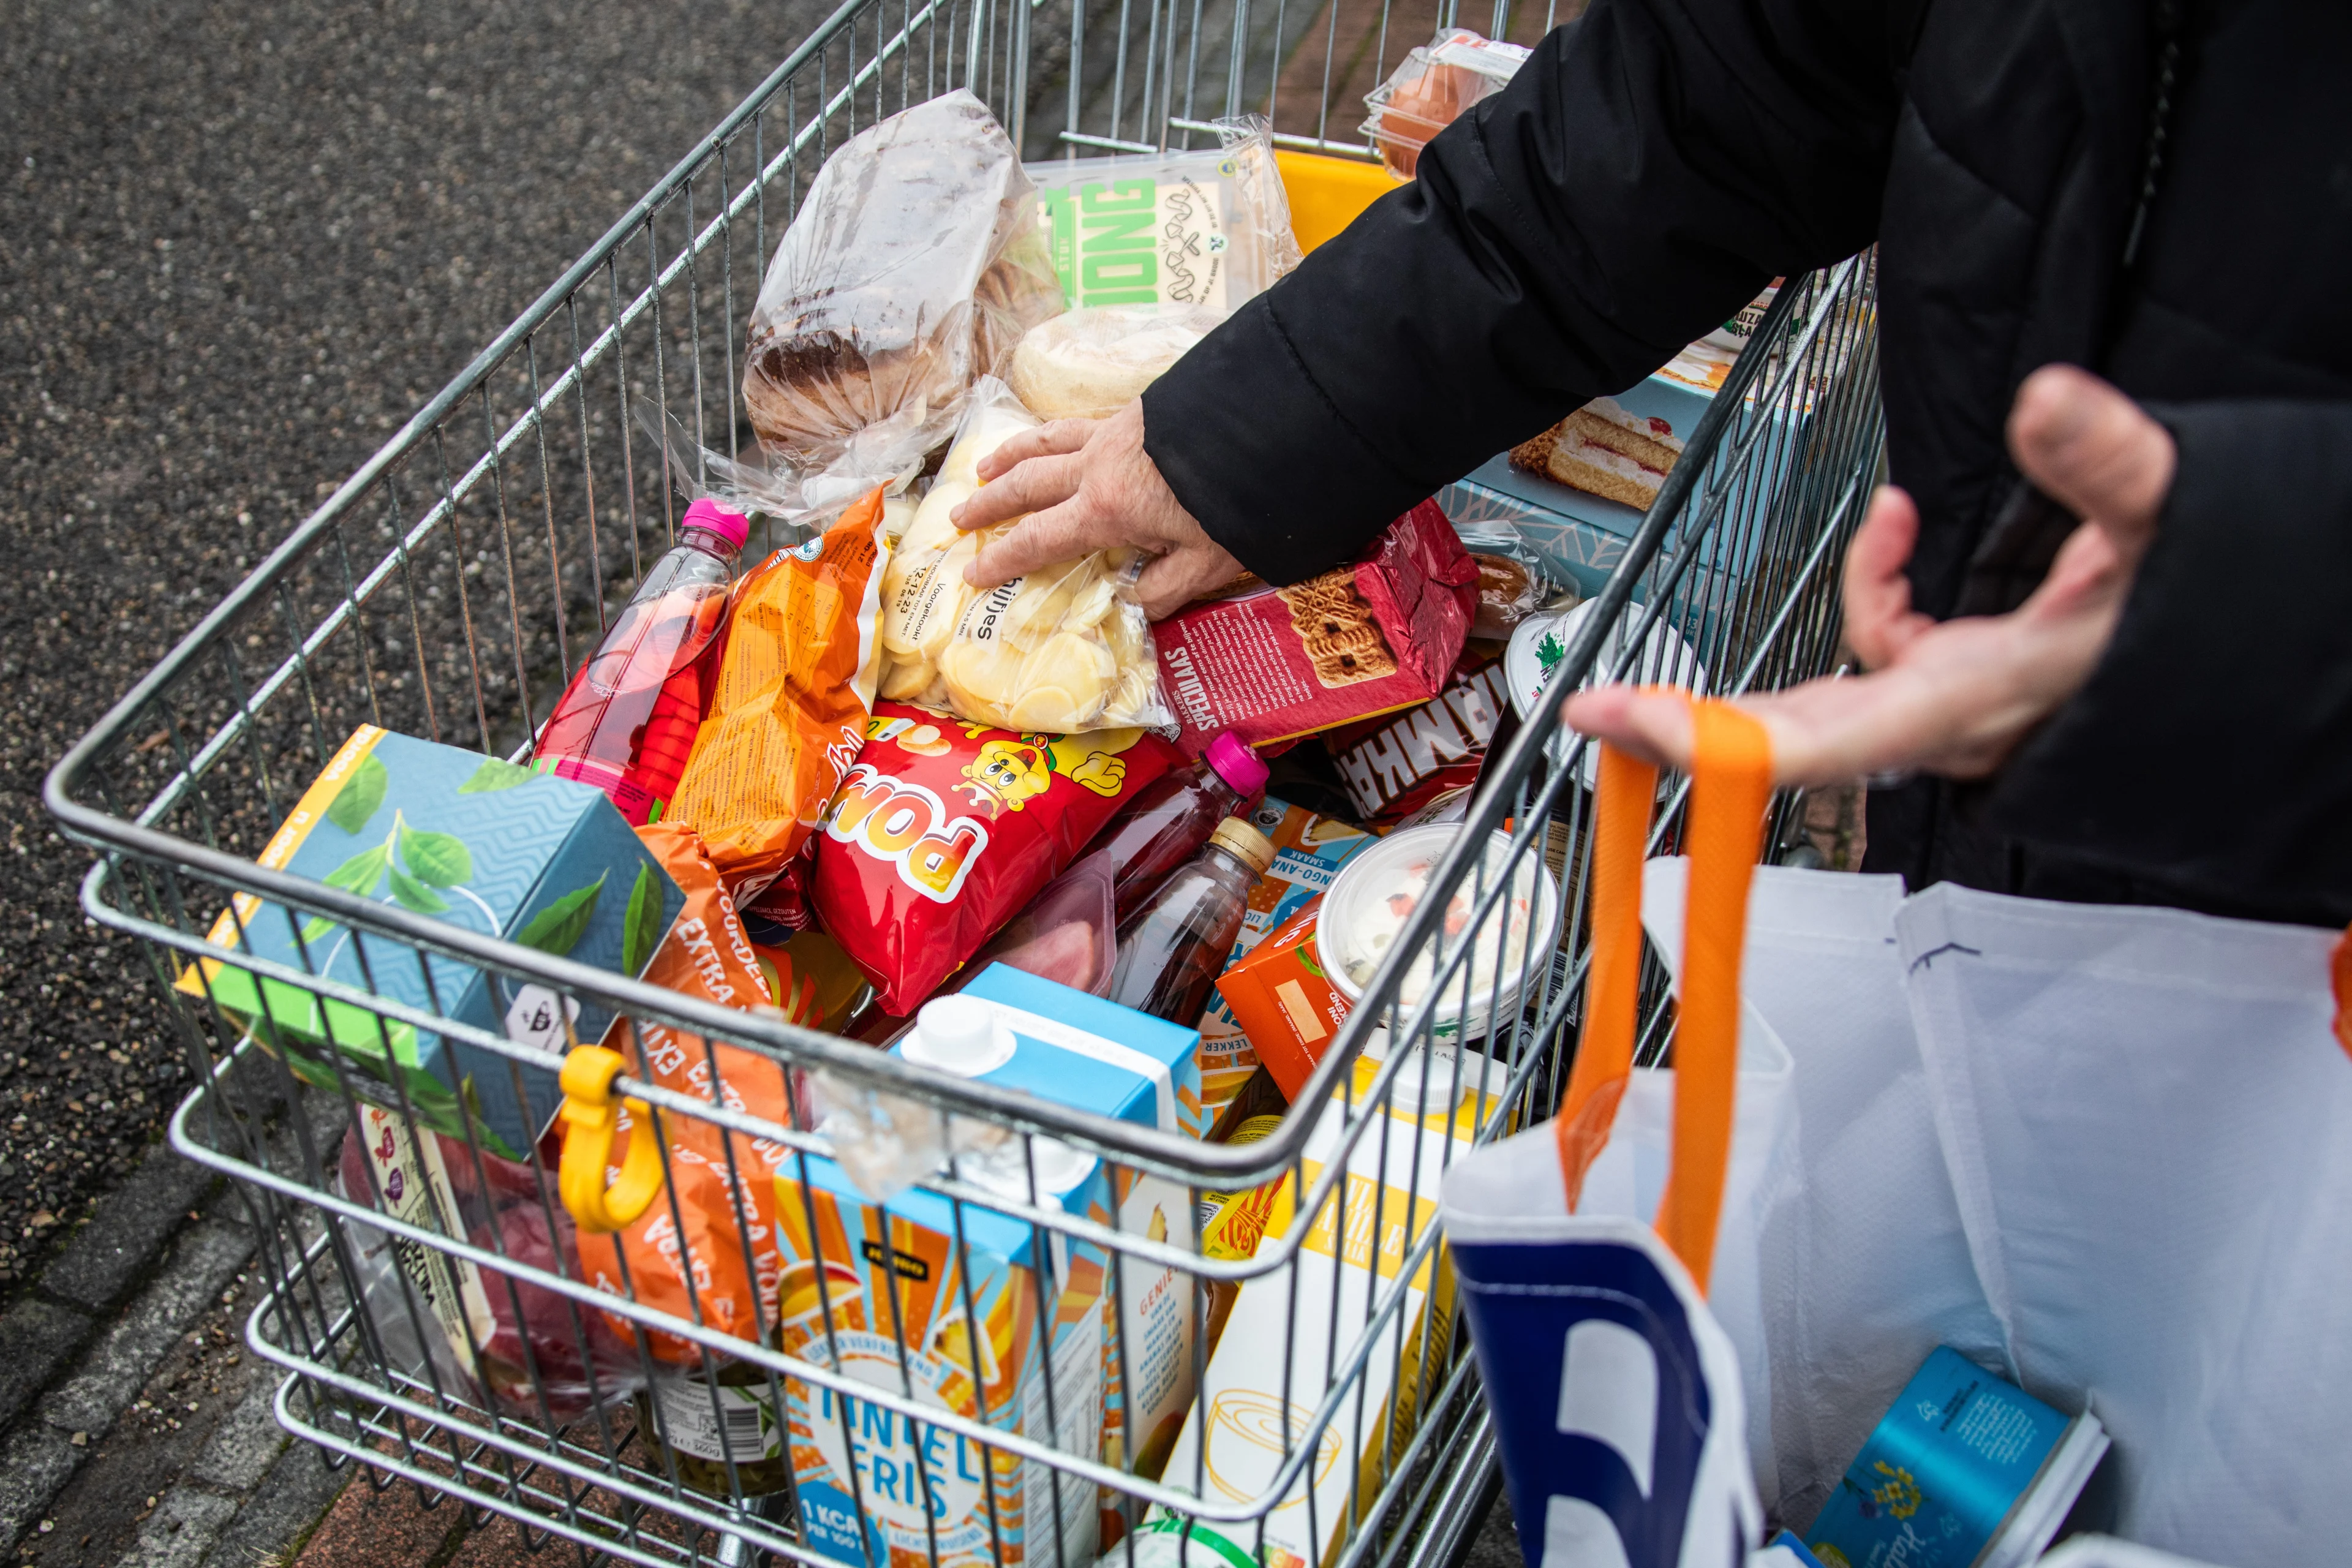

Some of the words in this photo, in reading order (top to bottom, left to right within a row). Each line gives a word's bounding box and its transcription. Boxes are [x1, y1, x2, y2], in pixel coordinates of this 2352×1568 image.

[1058, 236, 1069, 271] STUK
[856, 535, 878, 562] 21-08-
[898, 564, 927, 614] 12-12-23
[918, 564, 938, 598] HOUDBAAR
[895, 588, 907, 607] 06:19
[907, 611, 914, 621] EN
[910, 580, 946, 642] Voorgekookt
[963, 611, 971, 622] 3-5
[976, 577, 1023, 641] hijfjes
[1210, 609, 1219, 620] het
[1244, 602, 1254, 617] want
[1205, 618, 1215, 632] weer
[1235, 601, 1255, 638] koektrommel
[1251, 616, 1267, 640] verstopt,
[1261, 617, 1274, 636] Jumbo
[957, 622, 966, 638] MIN.
[1177, 618, 1194, 644] blijven!
[1191, 627, 1199, 638] een
[1197, 620, 1210, 639] bezoek
[1218, 625, 1231, 646] Voordat
[1228, 625, 1237, 635] op.
[1233, 617, 1248, 640] koekjes?
[1189, 643, 1197, 651] te
[1196, 636, 1208, 655] drinkt,
[1212, 631, 1224, 651] telkens
[1231, 633, 1242, 649] weer
[1261, 639, 1273, 654] goed
[1269, 634, 1279, 646] pak
[1192, 650, 1200, 658] af
[1209, 644, 1218, 657] voor
[1227, 645, 1242, 670] iedereen.
[1246, 645, 1254, 656] van
[1251, 636, 1268, 666] luchtdichte
[1274, 645, 1283, 656] een
[1197, 658, 1207, 674] eens
[1203, 654, 1212, 665] ook
[1214, 657, 1226, 674] Lekker
[1223, 655, 1235, 673] koekje
[1243, 660, 1253, 671] zijn
[1250, 655, 1264, 676] hebben
[1268, 653, 1277, 666] echt
[1208, 664, 1218, 677] thee
[1231, 673, 1239, 683] Een
[1238, 669, 1248, 682] voor
[1248, 670, 1258, 684] hebt
[1265, 665, 1273, 676] een
[1284, 665, 1297, 686] openen
[1204, 674, 1215, 692] maar
[1222, 673, 1232, 687] erbij.
[1260, 674, 1273, 693] plezier
[1269, 676, 1278, 687] dan
[1279, 676, 1287, 687] dat
[1298, 676, 1313, 700] koekjes...
[1164, 643, 1219, 735] SPECULAAS
[1216, 682, 1227, 698] koffie
[1228, 687, 1238, 702] hoort
[1235, 682, 1248, 699] jezelf.
[1244, 681, 1258, 704] traktatie
[1254, 682, 1266, 699] gaten
[1274, 685, 1288, 707] Gebruik
[1284, 685, 1294, 698] zorg
[1292, 685, 1301, 695] het
[1171, 689, 1194, 724] BAKKERS
[1242, 698, 1251, 711] voor
[1254, 703, 1263, 715] een
[1261, 698, 1268, 706] de
[1268, 692, 1281, 709] langer
[1214, 699, 1229, 725] Probeer
[1228, 709, 1237, 721] Hoe
[1234, 701, 1247, 720] koekje
[292, 807, 312, 827] u
[1289, 850, 1325, 867] SMAAK
[1270, 858, 1332, 886] NGO-ANA
[676, 915, 736, 1004] EXTRA
[1276, 1000, 1287, 1015] JAAR)
[1283, 1013, 1297, 1033] (MAAND,
[1326, 1005, 1347, 1035] RONI
[1204, 1038, 1247, 1052] LEKKER
[1293, 1031, 1305, 1046] EINDE:
[1301, 1044, 1310, 1055] TOT
[1139, 1269, 1175, 1316] GENIE
[853, 1442, 947, 1519] FRIS
[797, 1497, 818, 1520] 1
[811, 1503, 866, 1538] KCA
